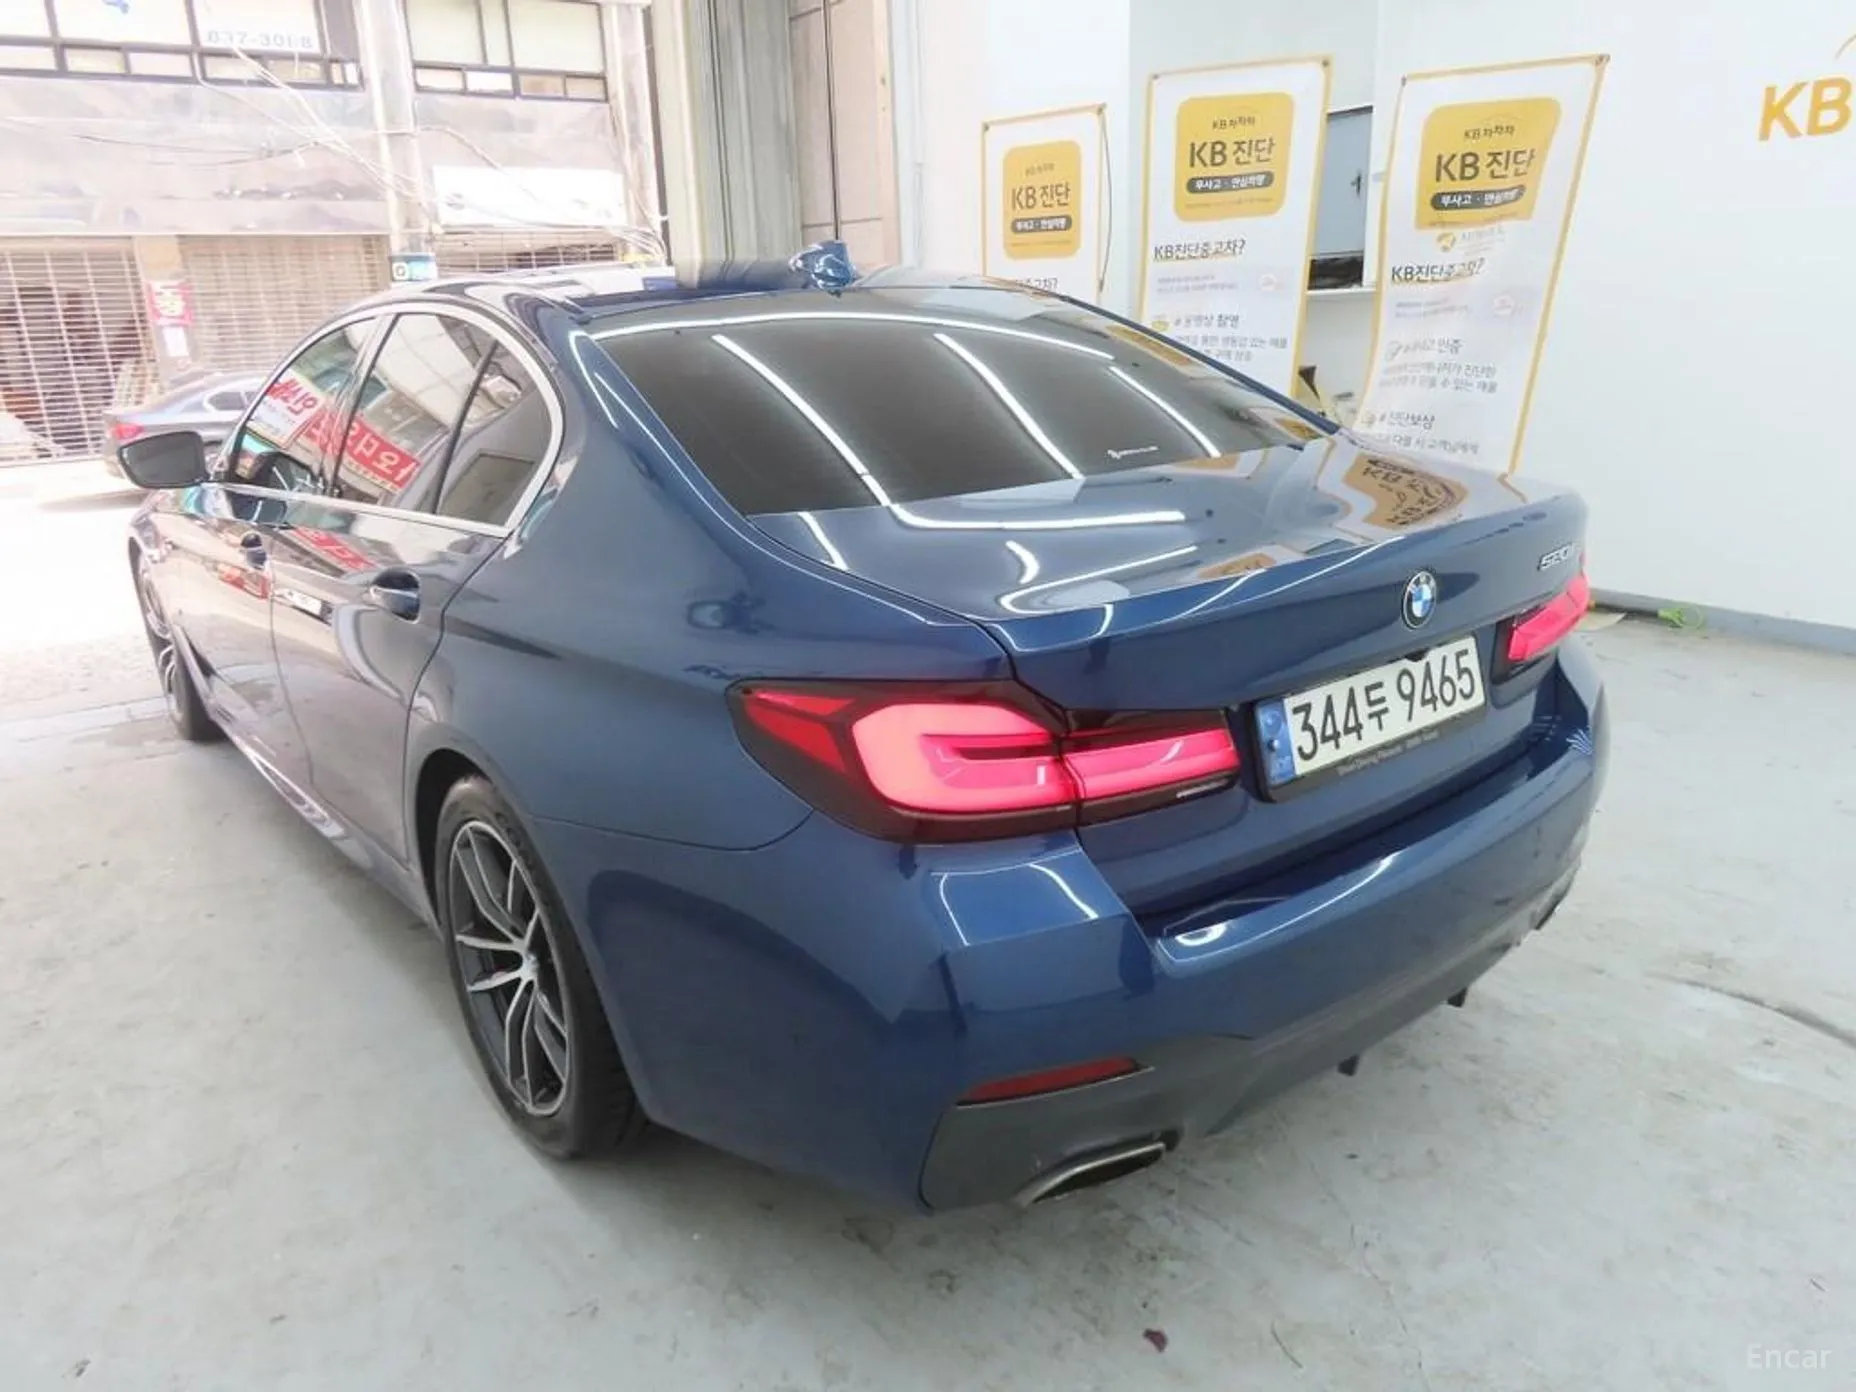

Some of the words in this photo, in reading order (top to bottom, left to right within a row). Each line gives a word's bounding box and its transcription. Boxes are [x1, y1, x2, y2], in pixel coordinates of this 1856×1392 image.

[1759, 78, 1852, 141] KB
[1189, 140, 1227, 168] KB
[1232, 137, 1276, 165] 진단
[1435, 152, 1480, 182] KB
[1486, 148, 1536, 179] 진단
[1011, 185, 1037, 211] KB
[1040, 182, 1071, 208] 진단
[1154, 238, 1246, 261] KB진단중고차?
[1292, 682, 1390, 761] 344두
[1397, 648, 1476, 722] 9465
